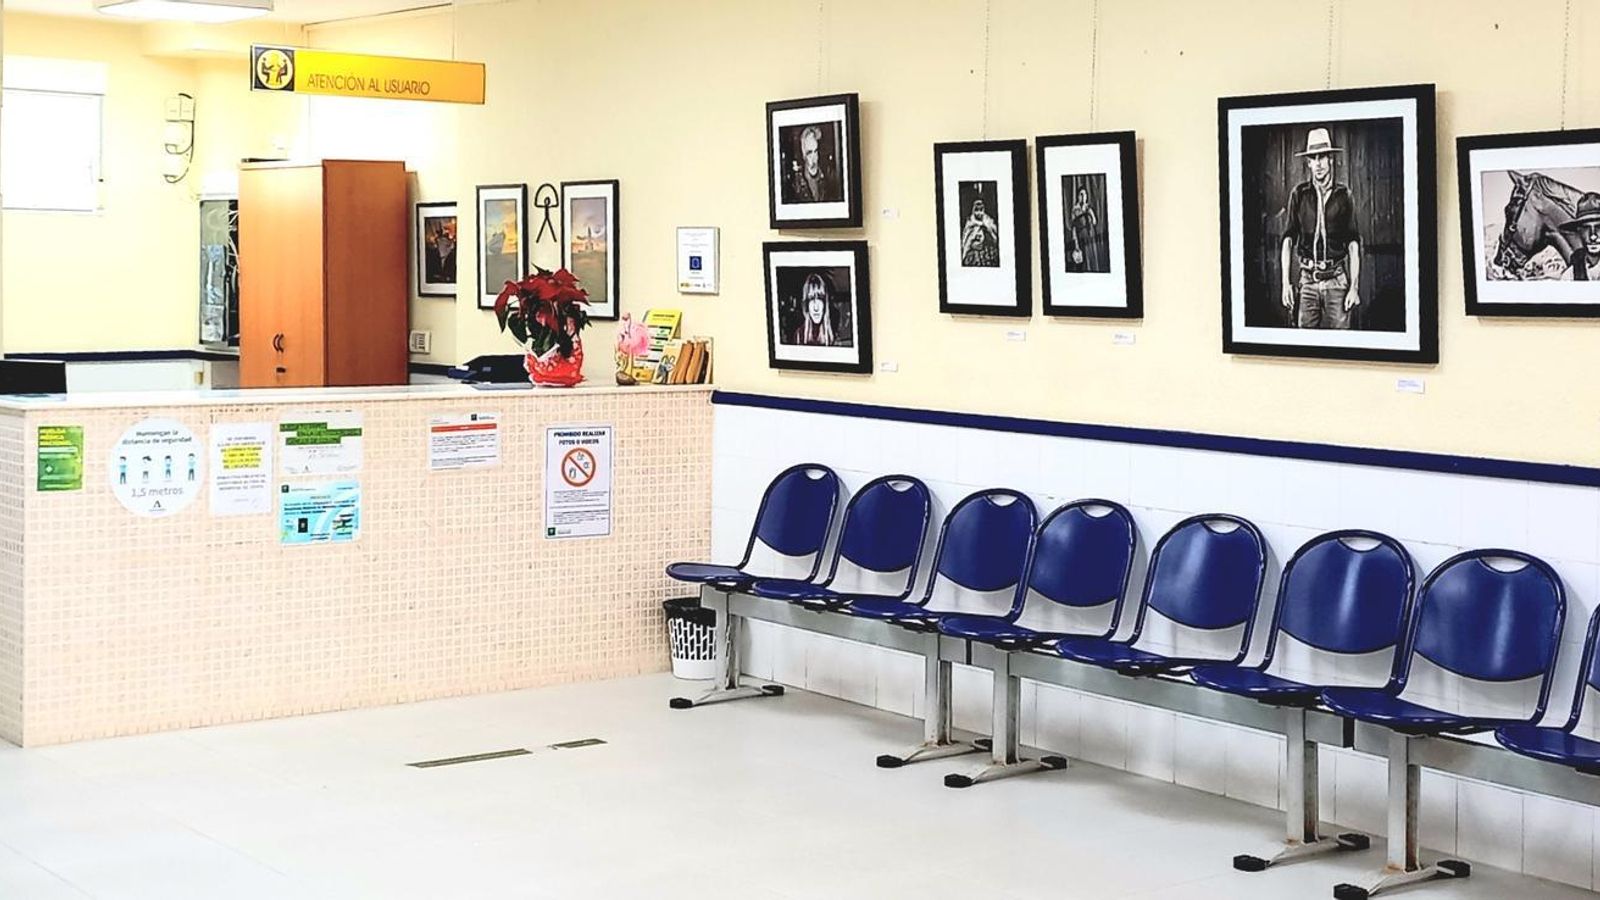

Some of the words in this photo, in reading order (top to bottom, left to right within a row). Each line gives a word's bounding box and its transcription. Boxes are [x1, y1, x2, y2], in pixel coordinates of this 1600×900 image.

[306, 72, 365, 91] ATENCIÓN
[368, 78, 381, 92] AL
[384, 79, 431, 95] USUARIO
[131, 487, 147, 497] 1,5
[148, 487, 184, 496] metros
